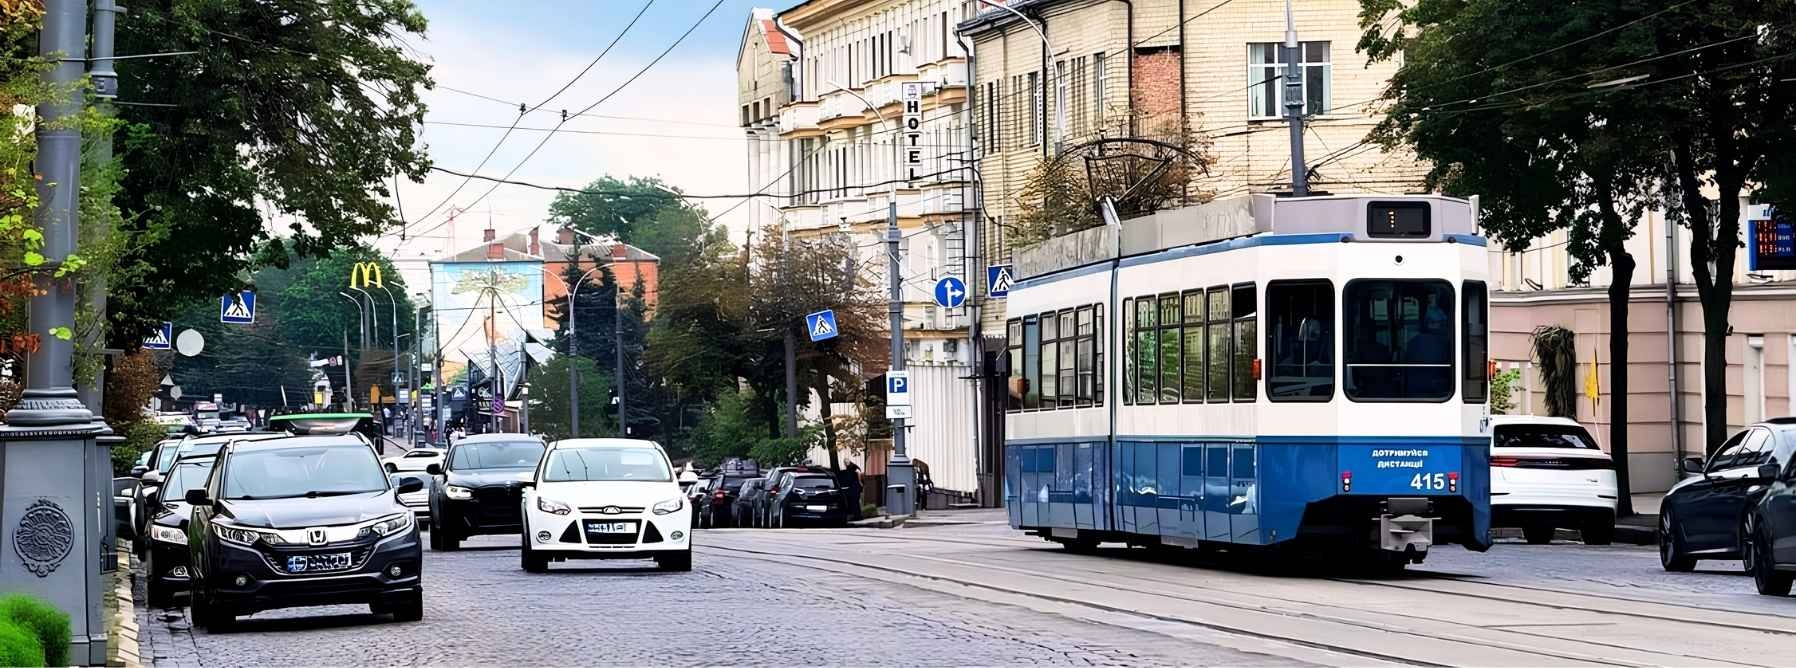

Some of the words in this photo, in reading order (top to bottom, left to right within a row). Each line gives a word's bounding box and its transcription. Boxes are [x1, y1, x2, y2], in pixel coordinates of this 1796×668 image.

[907, 100, 921, 181] HOTEL
[893, 378, 904, 392] P
[1410, 472, 1445, 490] 415
